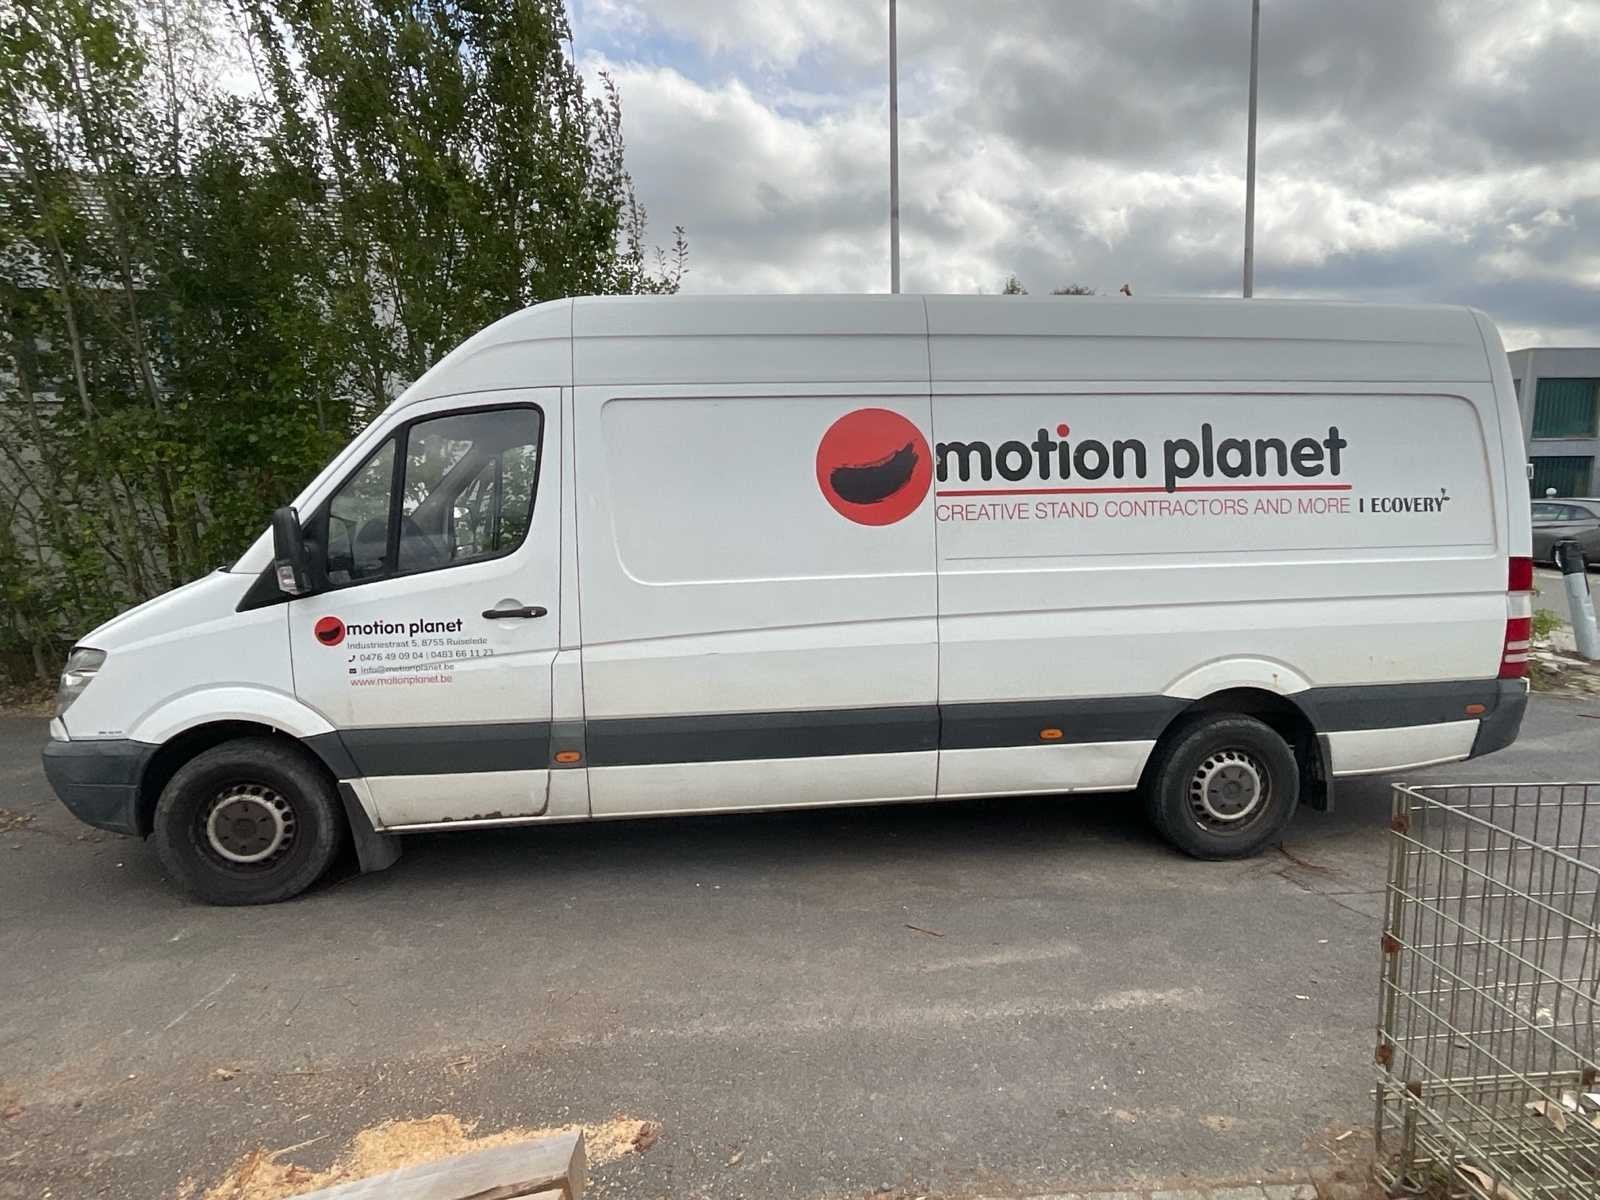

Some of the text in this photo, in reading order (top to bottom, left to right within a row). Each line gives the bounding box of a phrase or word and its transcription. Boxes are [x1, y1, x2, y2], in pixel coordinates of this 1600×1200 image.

[935, 422, 1348, 493] motion planet
[936, 503, 1029, 522] CREATIVE
[1035, 501, 1099, 519] STAND
[1104, 498, 1248, 518] CONTRACTORS
[1254, 497, 1293, 516] AND
[1298, 497, 1351, 514] MORE
[1371, 496, 1444, 513] ECOVERY
[347, 618, 463, 637] motion planet
[421, 638, 444, 647] 8755
[359, 652, 383, 662] 0476
[384, 652, 396, 661] 49
[412, 651, 424, 660] 04
[469, 648, 479, 657] 11
[350, 675, 453, 687] www.motionplanet.be
